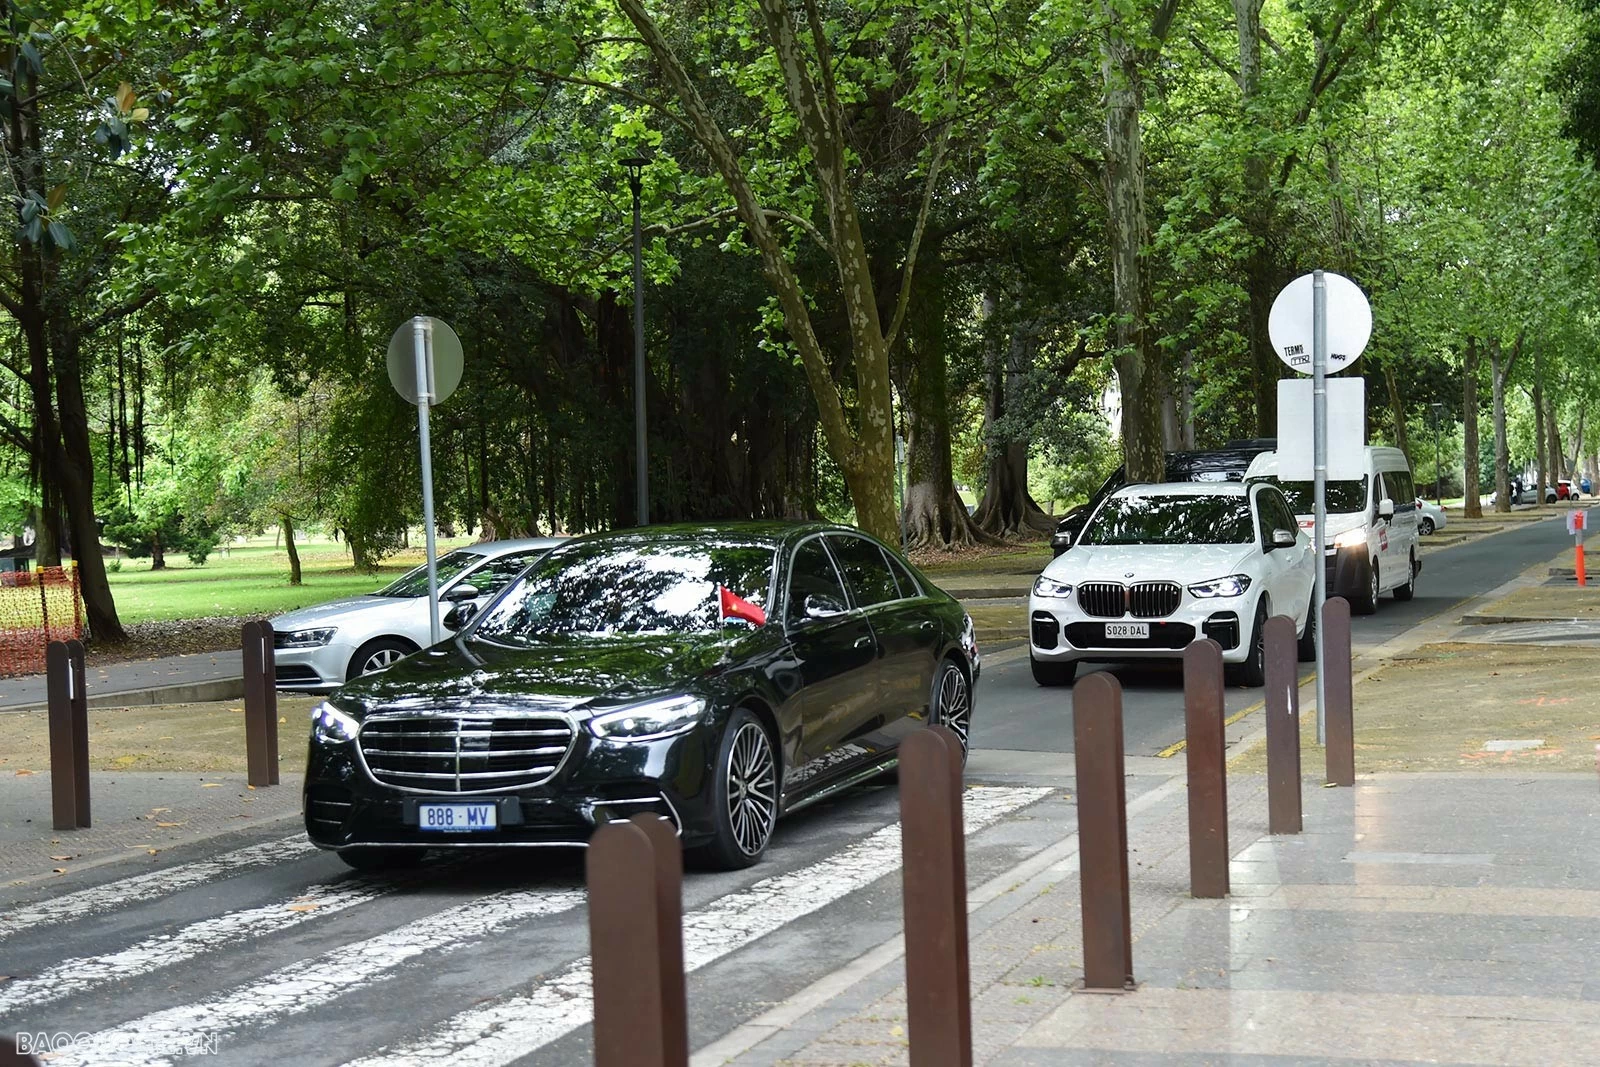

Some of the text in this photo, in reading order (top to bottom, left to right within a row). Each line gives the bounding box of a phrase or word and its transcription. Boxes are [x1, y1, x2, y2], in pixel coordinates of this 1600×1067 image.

[1106, 626, 1147, 636] S028 DAL
[427, 807, 489, 825] 888 MV
